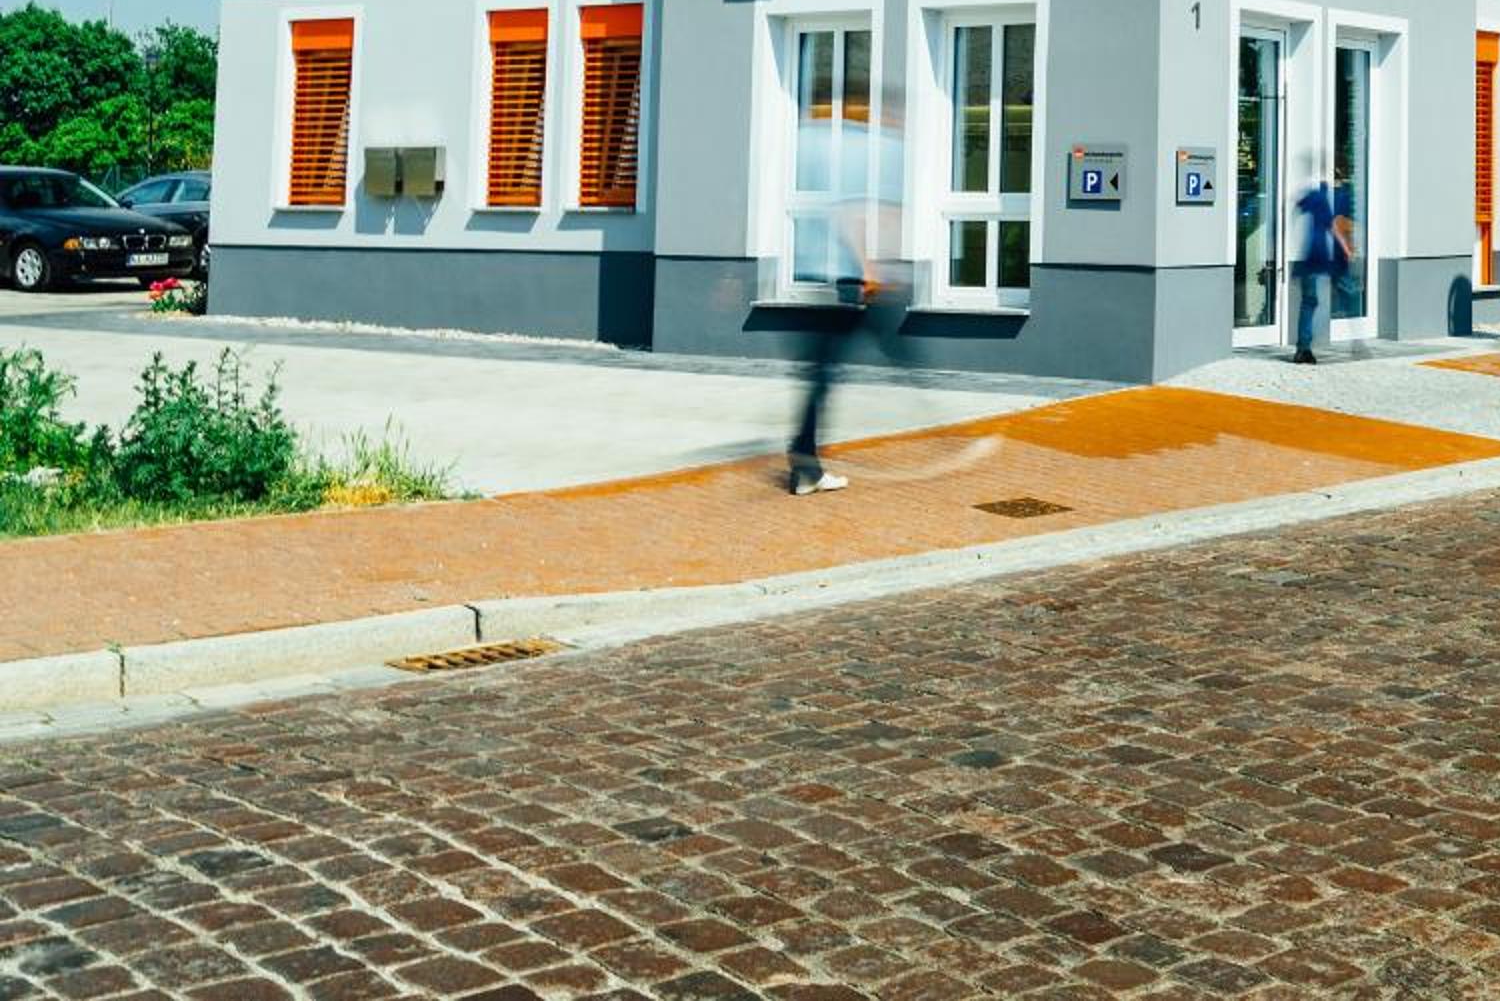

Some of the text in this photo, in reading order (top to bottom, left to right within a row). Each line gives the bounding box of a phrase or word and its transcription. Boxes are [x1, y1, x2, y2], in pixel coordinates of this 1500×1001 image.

[1191, 2, 1201, 30] 1
[1086, 172, 1098, 192] P
[1189, 175, 1197, 194] P
